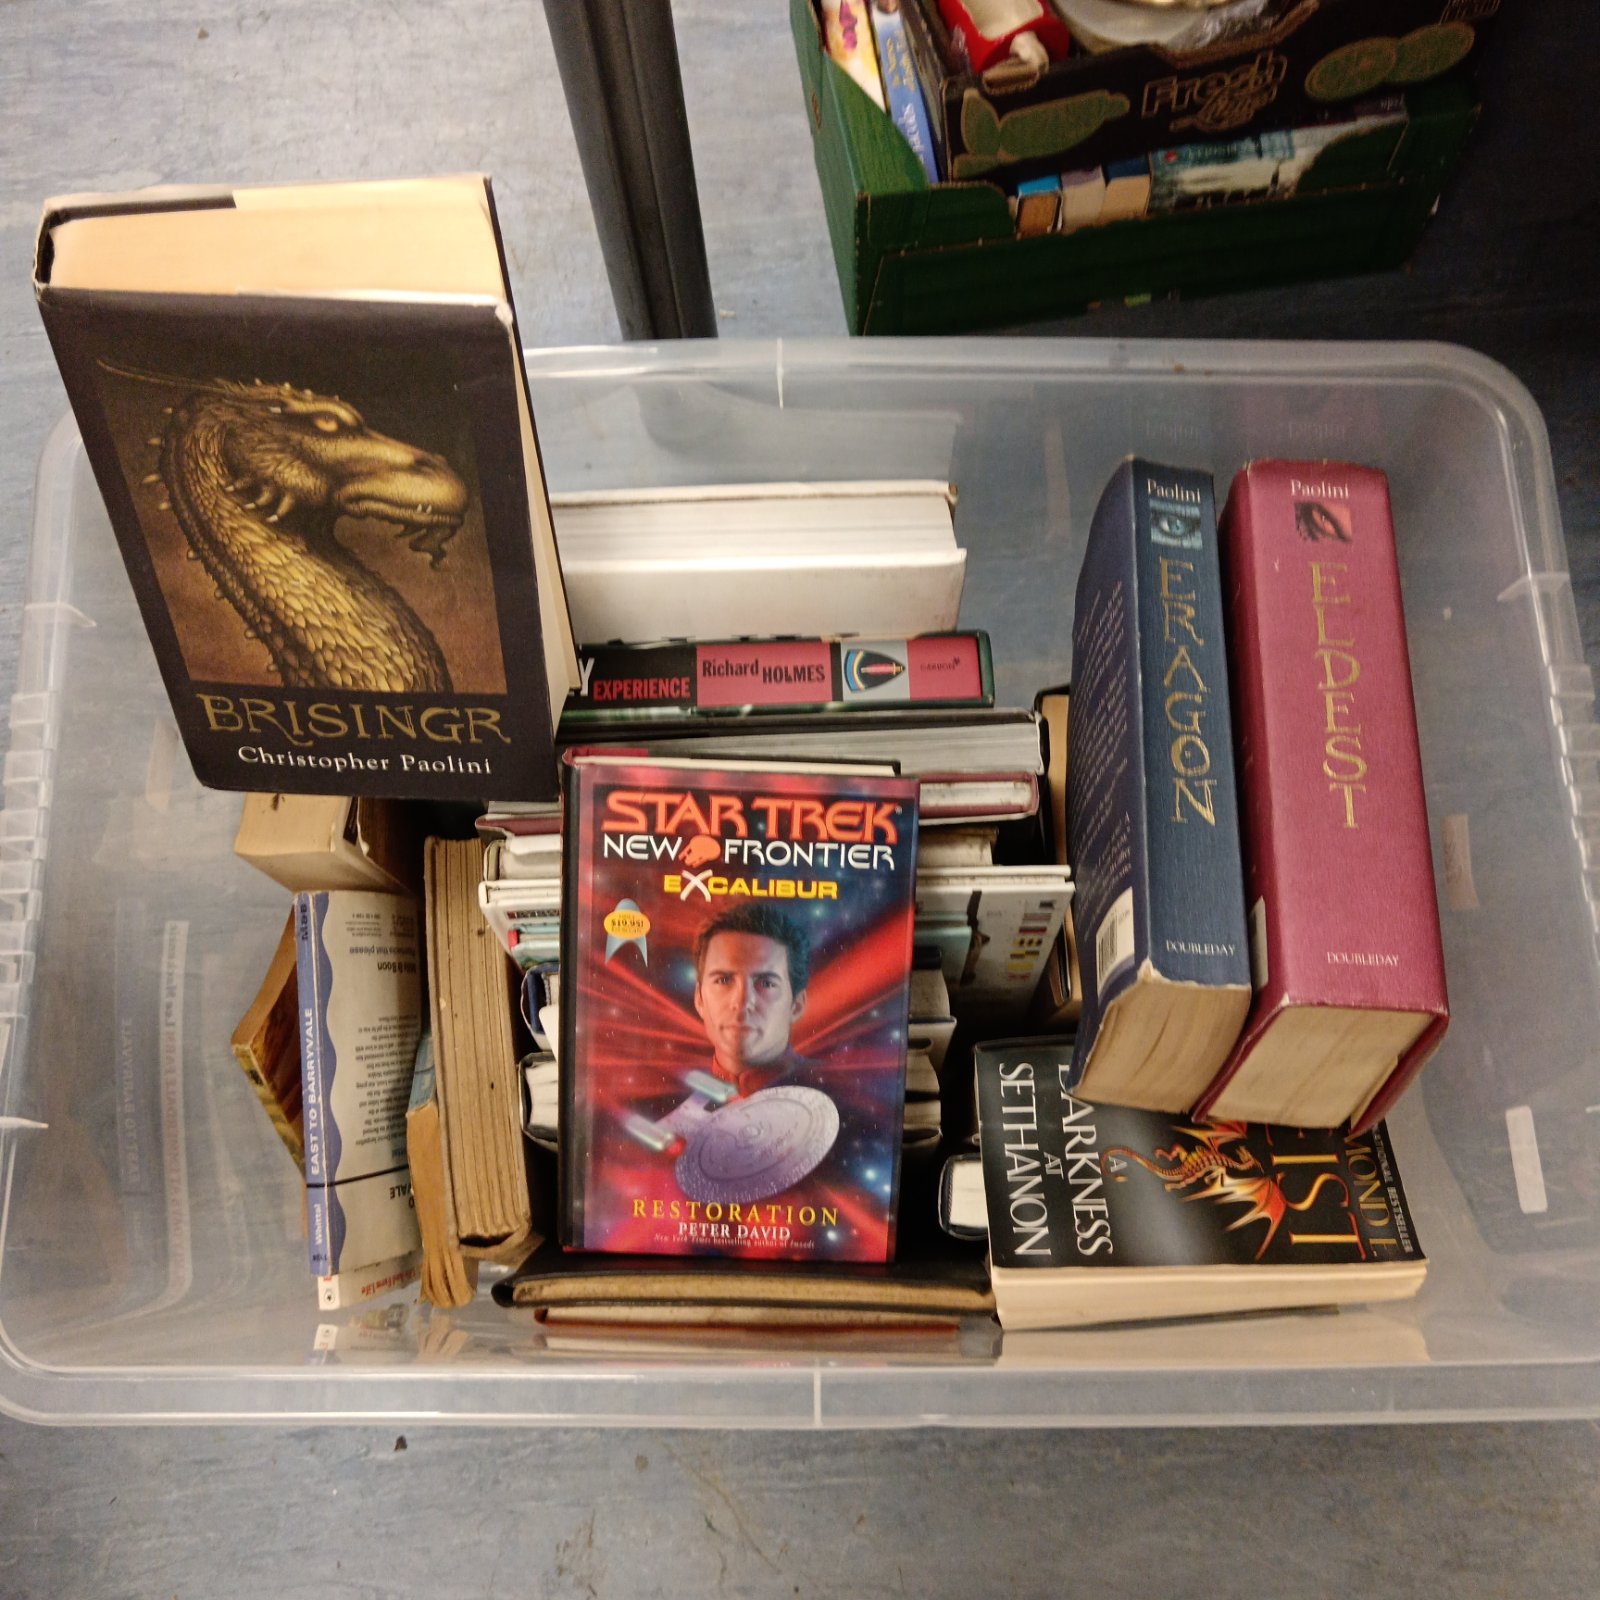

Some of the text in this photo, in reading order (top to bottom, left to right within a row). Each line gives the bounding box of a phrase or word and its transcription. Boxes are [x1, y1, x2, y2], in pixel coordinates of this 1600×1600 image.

[1147, 478, 1200, 502] Paolini
[1290, 479, 1348, 499] Paolini
[702, 658, 826, 685] Richard HOLMES
[592, 677, 690, 701] EXPERIENCE
[1159, 556, 1217, 826] ERAGON
[1308, 561, 1368, 829] ELDEST
[196, 693, 512, 747] BRISINGR
[238, 745, 493, 775] Christopher Paolini
[601, 790, 899, 845] STAR TREK
[603, 833, 896, 871] NEW FRONTIER
[663, 869, 839, 902] EXCALIBUR
[1166, 939, 1236, 956] DOUBLEDAY
[1326, 951, 1400, 967] DOUBLEDAY
[304, 1008, 320, 1176] EAST TO BARRYVALE
[999, 1062, 1052, 1256] SETHANON
[1043, 1151, 1065, 1180] AT
[1108, 1156, 1128, 1173] A
[1343, 1132, 1391, 1227] MOND
[313, 1203, 323, 1246] Whittal
[633, 1199, 839, 1227] RESTORATION
[678, 1221, 791, 1241] PETER DAVID
